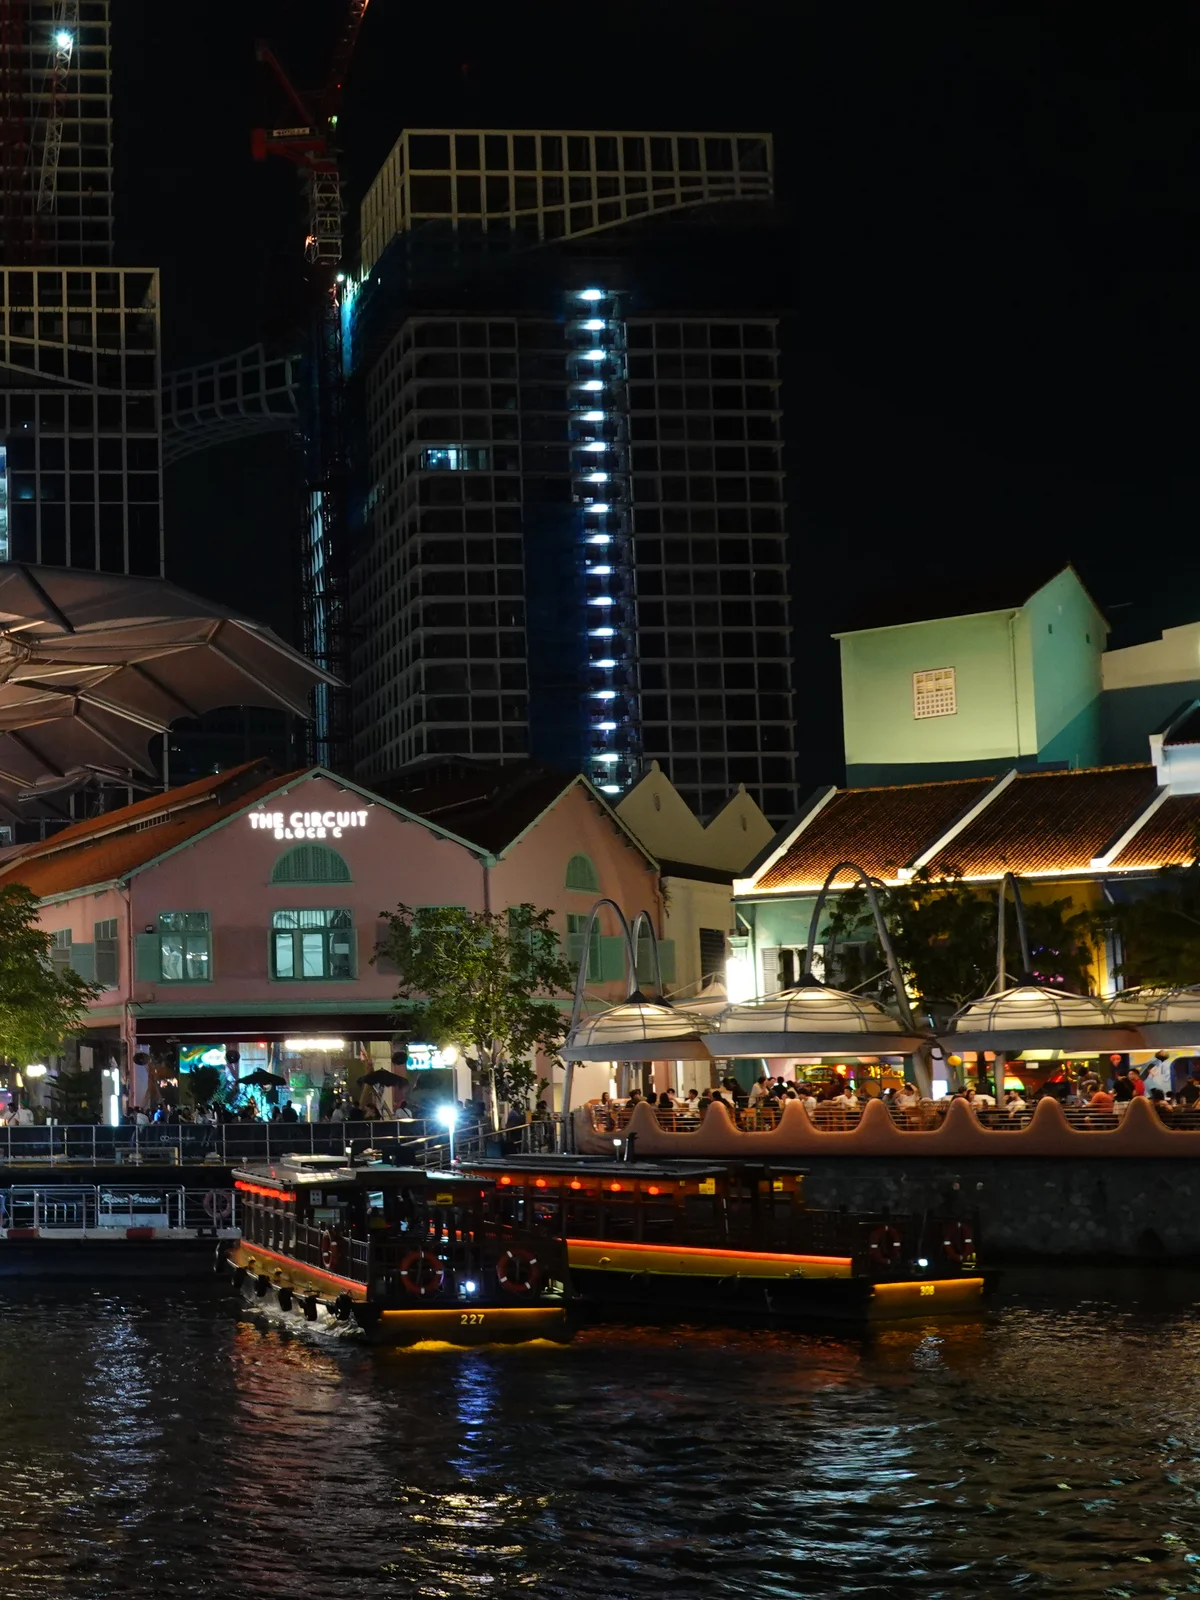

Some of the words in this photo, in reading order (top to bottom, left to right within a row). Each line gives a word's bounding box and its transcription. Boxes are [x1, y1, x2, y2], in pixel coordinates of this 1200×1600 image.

[248, 812, 284, 829] THE
[290, 811, 368, 828] CIRCUIT
[274, 827, 327, 839] BLOCK
[332, 826, 343, 838] C
[460, 1314, 485, 1325] 227
